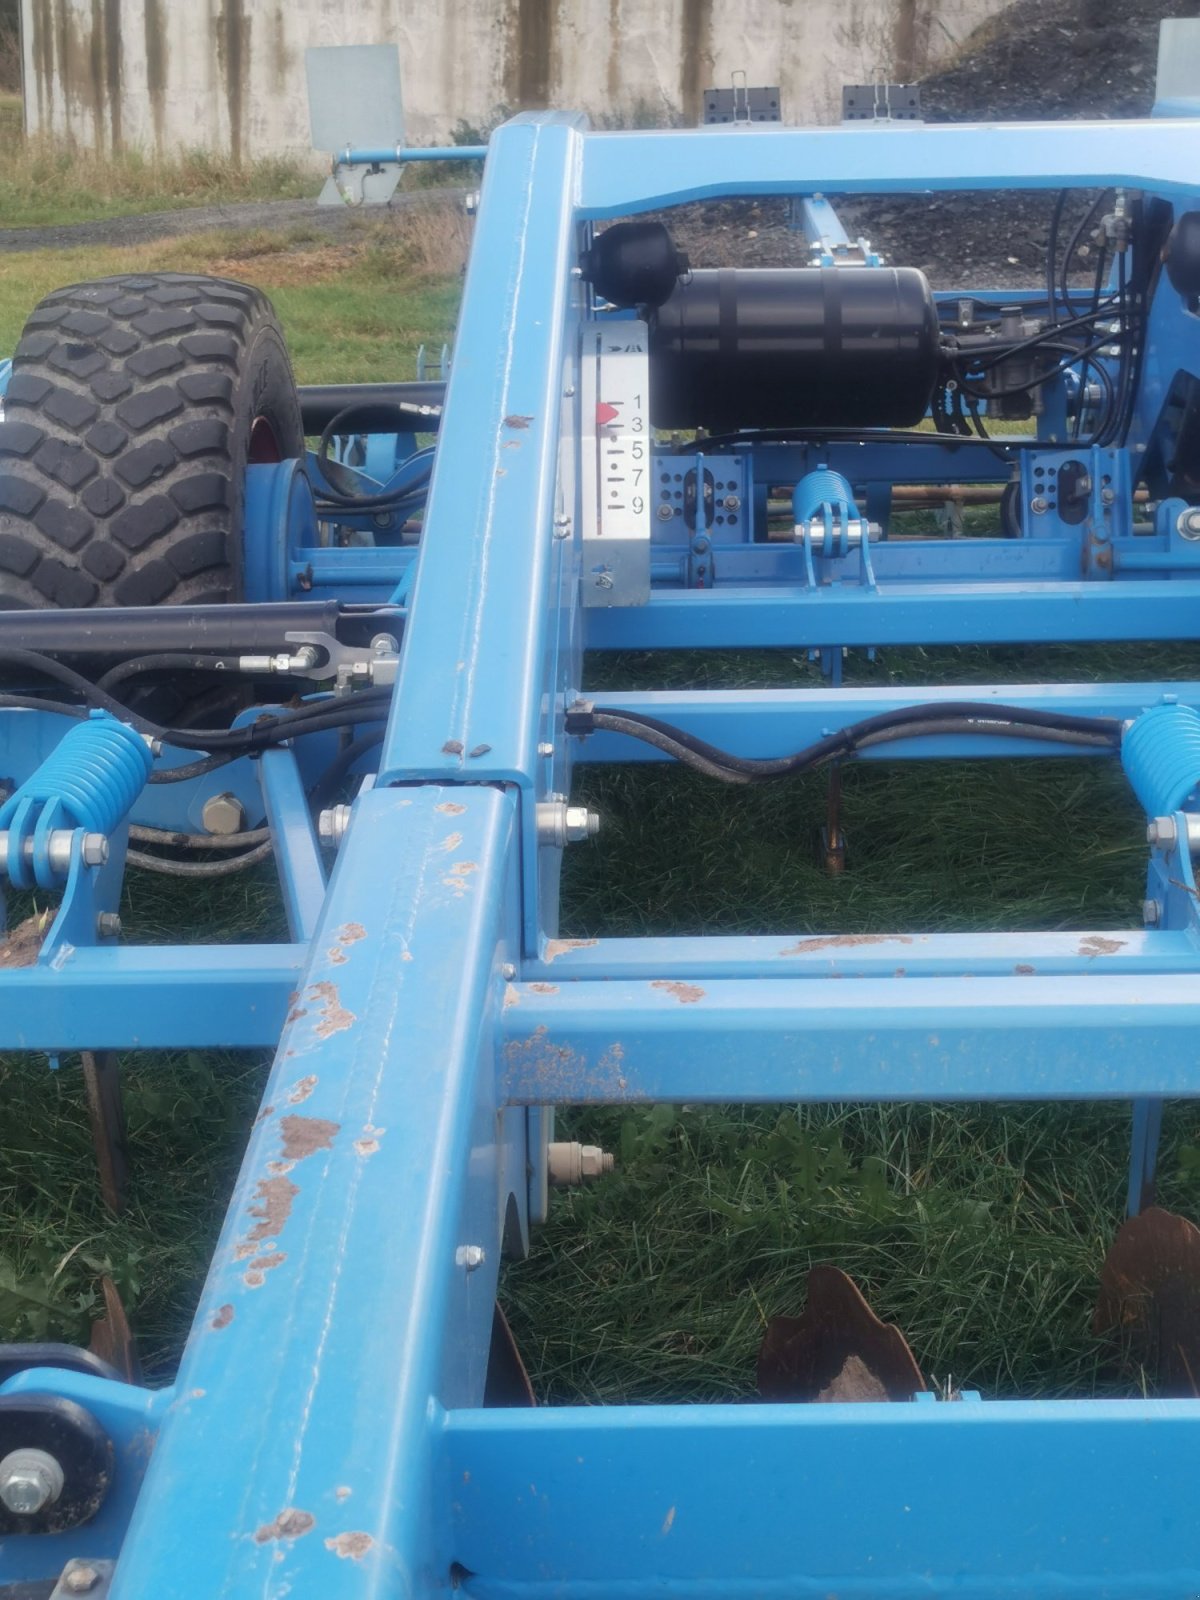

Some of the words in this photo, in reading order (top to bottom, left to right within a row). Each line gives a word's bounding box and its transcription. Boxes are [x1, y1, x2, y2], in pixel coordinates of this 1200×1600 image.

[633, 394, 641, 410] 1
[632, 416, 643, 432] 3
[632, 441, 643, 459] 5
[632, 468, 643, 486] 7
[632, 496, 644, 515] 9
